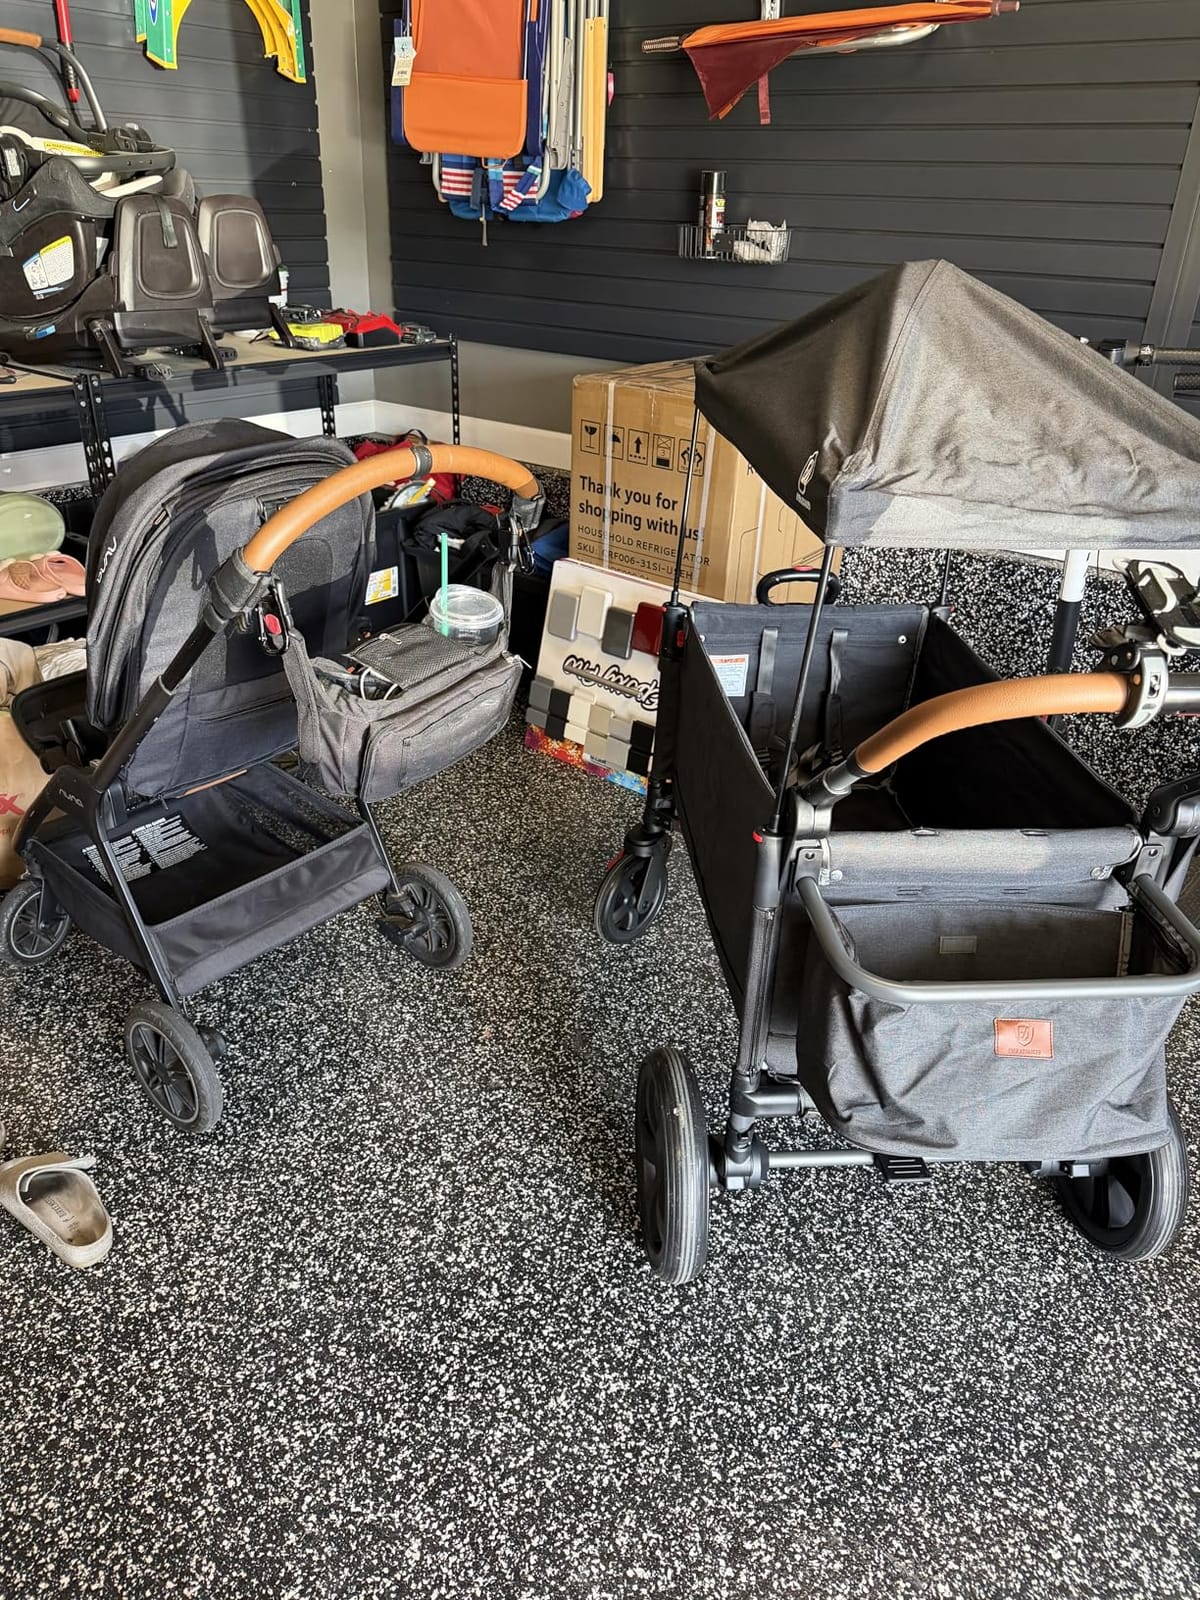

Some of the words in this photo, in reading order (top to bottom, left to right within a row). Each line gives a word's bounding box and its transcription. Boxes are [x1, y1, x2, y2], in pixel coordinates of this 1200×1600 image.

[624, 488, 651, 505] you
[656, 491, 678, 511] for
[646, 517, 678, 536] with
[636, 540, 710, 567] REFRIGEATOR
